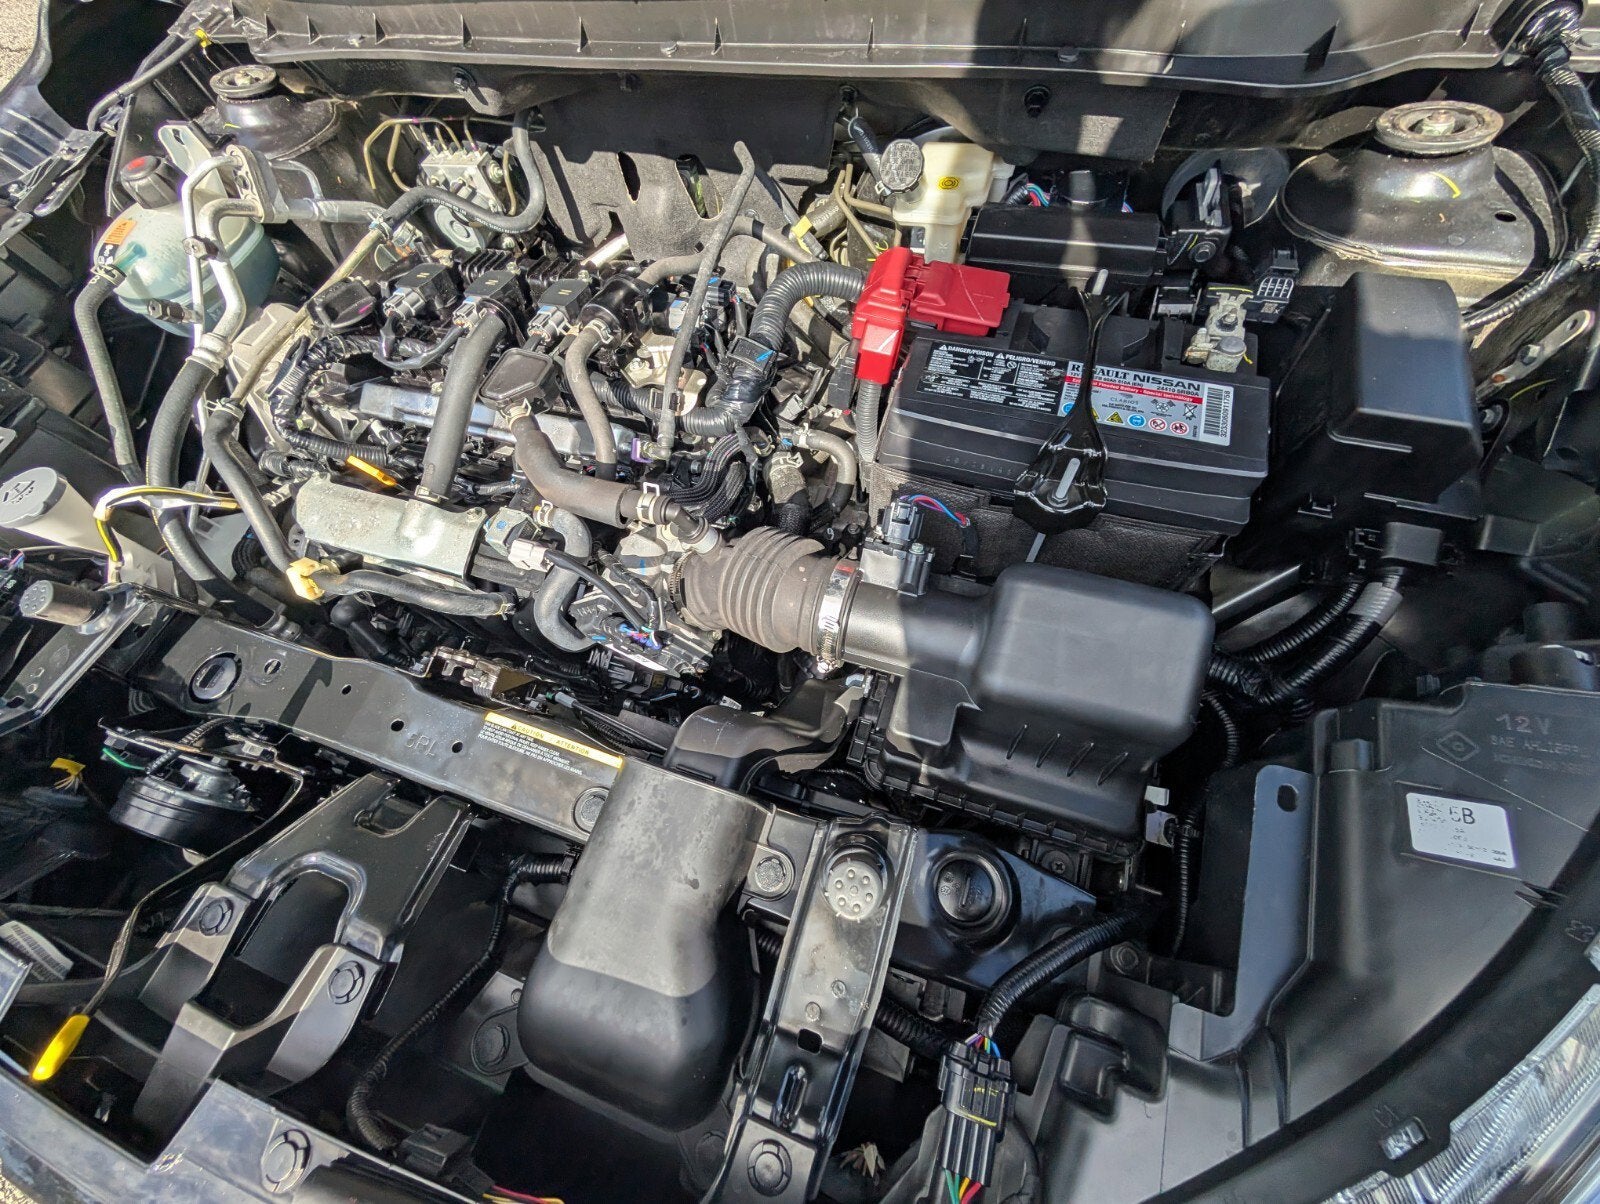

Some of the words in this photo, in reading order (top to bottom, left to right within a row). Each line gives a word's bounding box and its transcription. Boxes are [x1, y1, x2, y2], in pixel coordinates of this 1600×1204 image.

[948, 346, 994, 357] DANGER/POISON
[1070, 364, 1130, 380] RAULT
[1134, 374, 1200, 391] NISSAN
[517, 726, 544, 738] CAUTION
[555, 740, 590, 755] ATTENTION
